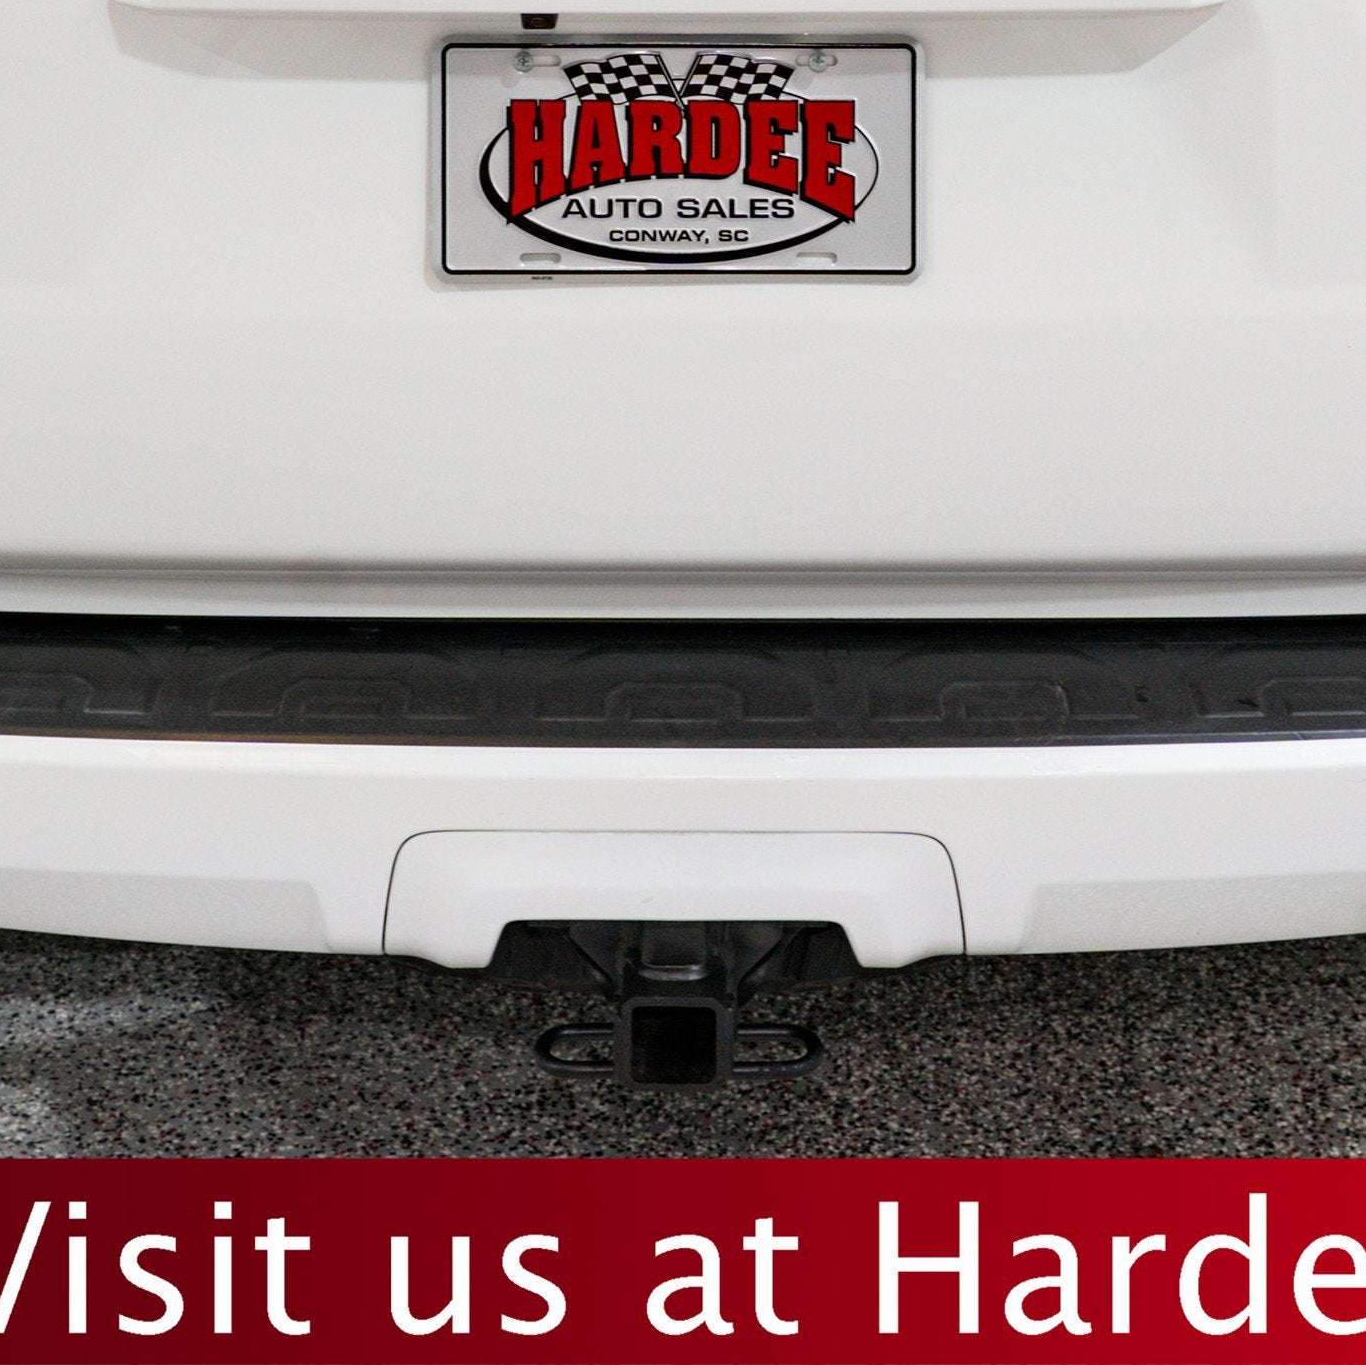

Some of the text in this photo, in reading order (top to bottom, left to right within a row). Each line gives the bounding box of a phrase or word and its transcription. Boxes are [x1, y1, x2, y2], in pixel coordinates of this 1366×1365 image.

[506, 98, 857, 224] HARDEE
[561, 197, 795, 220] AUTO SALES
[608, 228, 750, 245] CONWAY, SC
